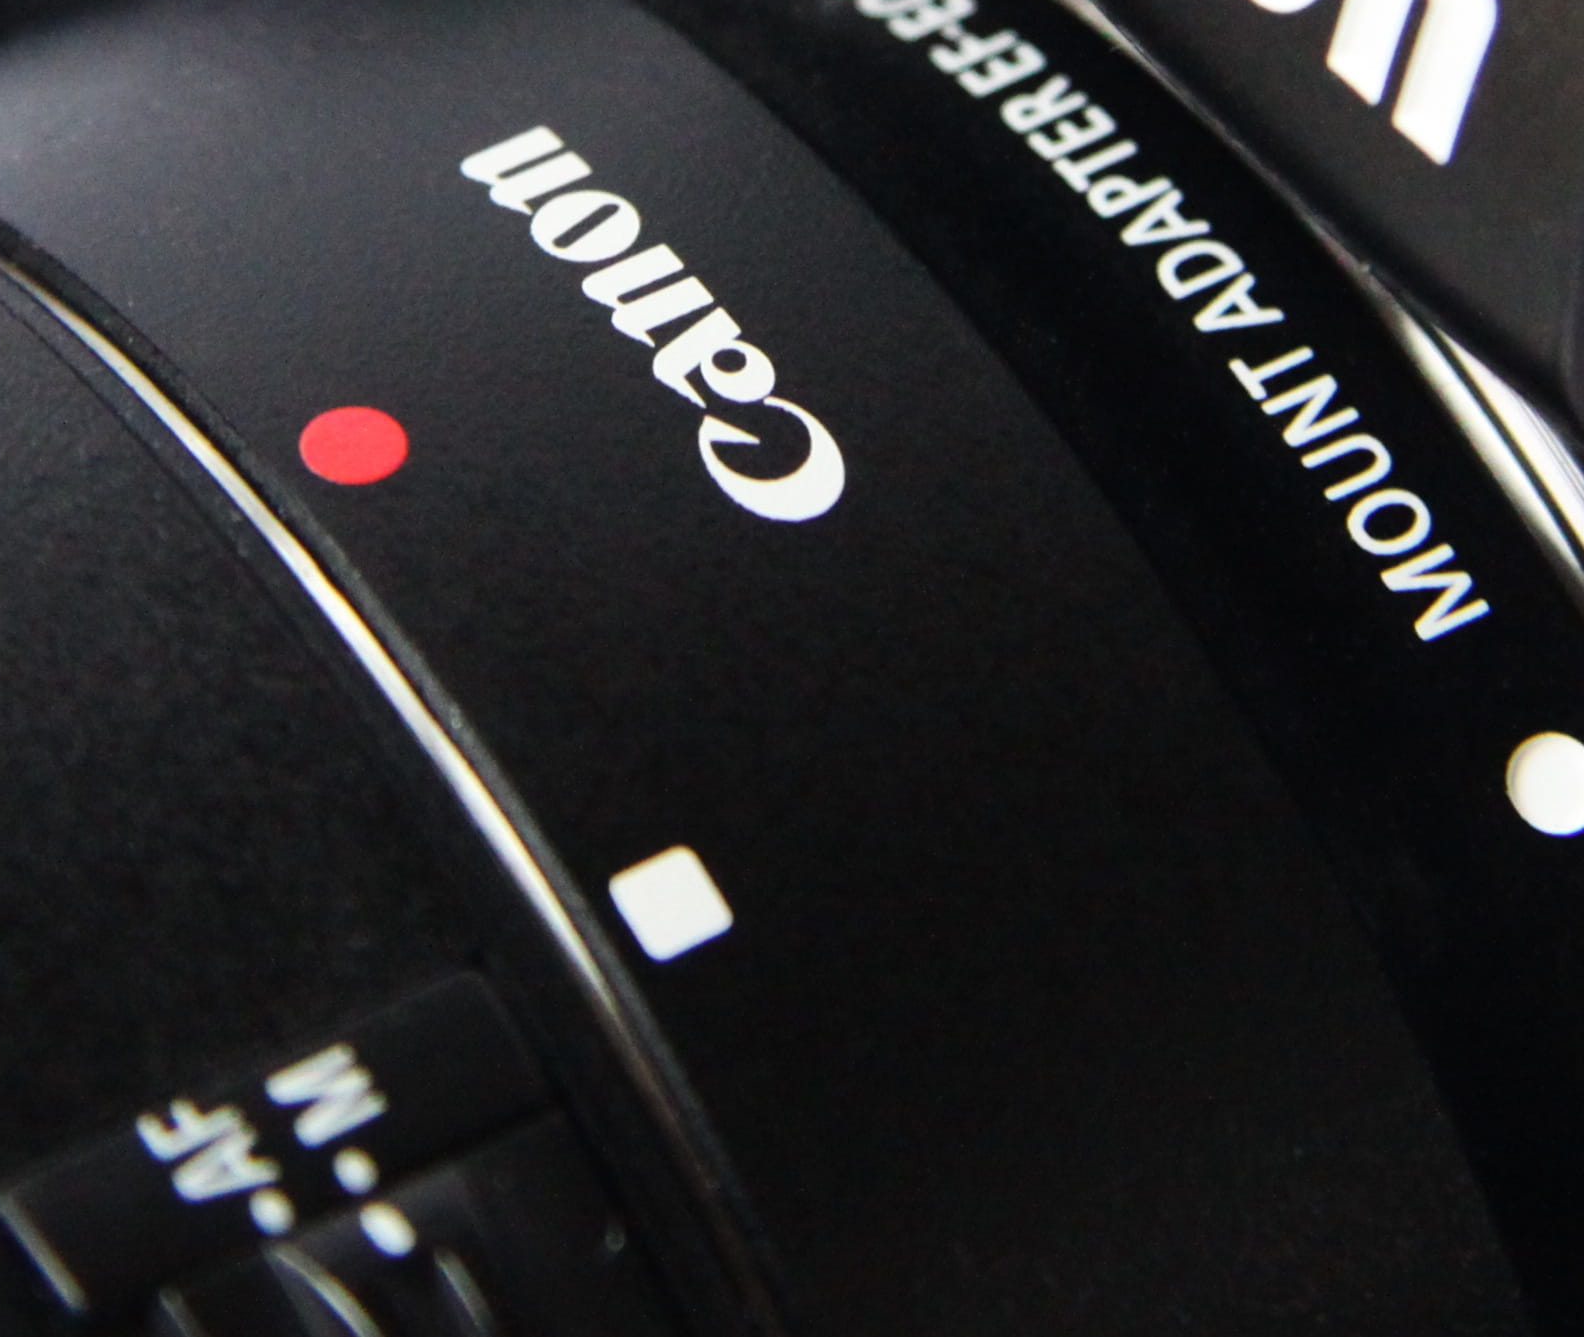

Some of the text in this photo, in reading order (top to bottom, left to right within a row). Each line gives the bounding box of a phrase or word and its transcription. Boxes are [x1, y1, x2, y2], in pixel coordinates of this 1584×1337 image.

[459, 124, 846, 523] Canon
[1000, 74, 1285, 333] ADAPTER
[1228, 346, 1491, 642] MOUNT
[135, 1099, 280, 1202] AF
[264, 1043, 386, 1148] M
